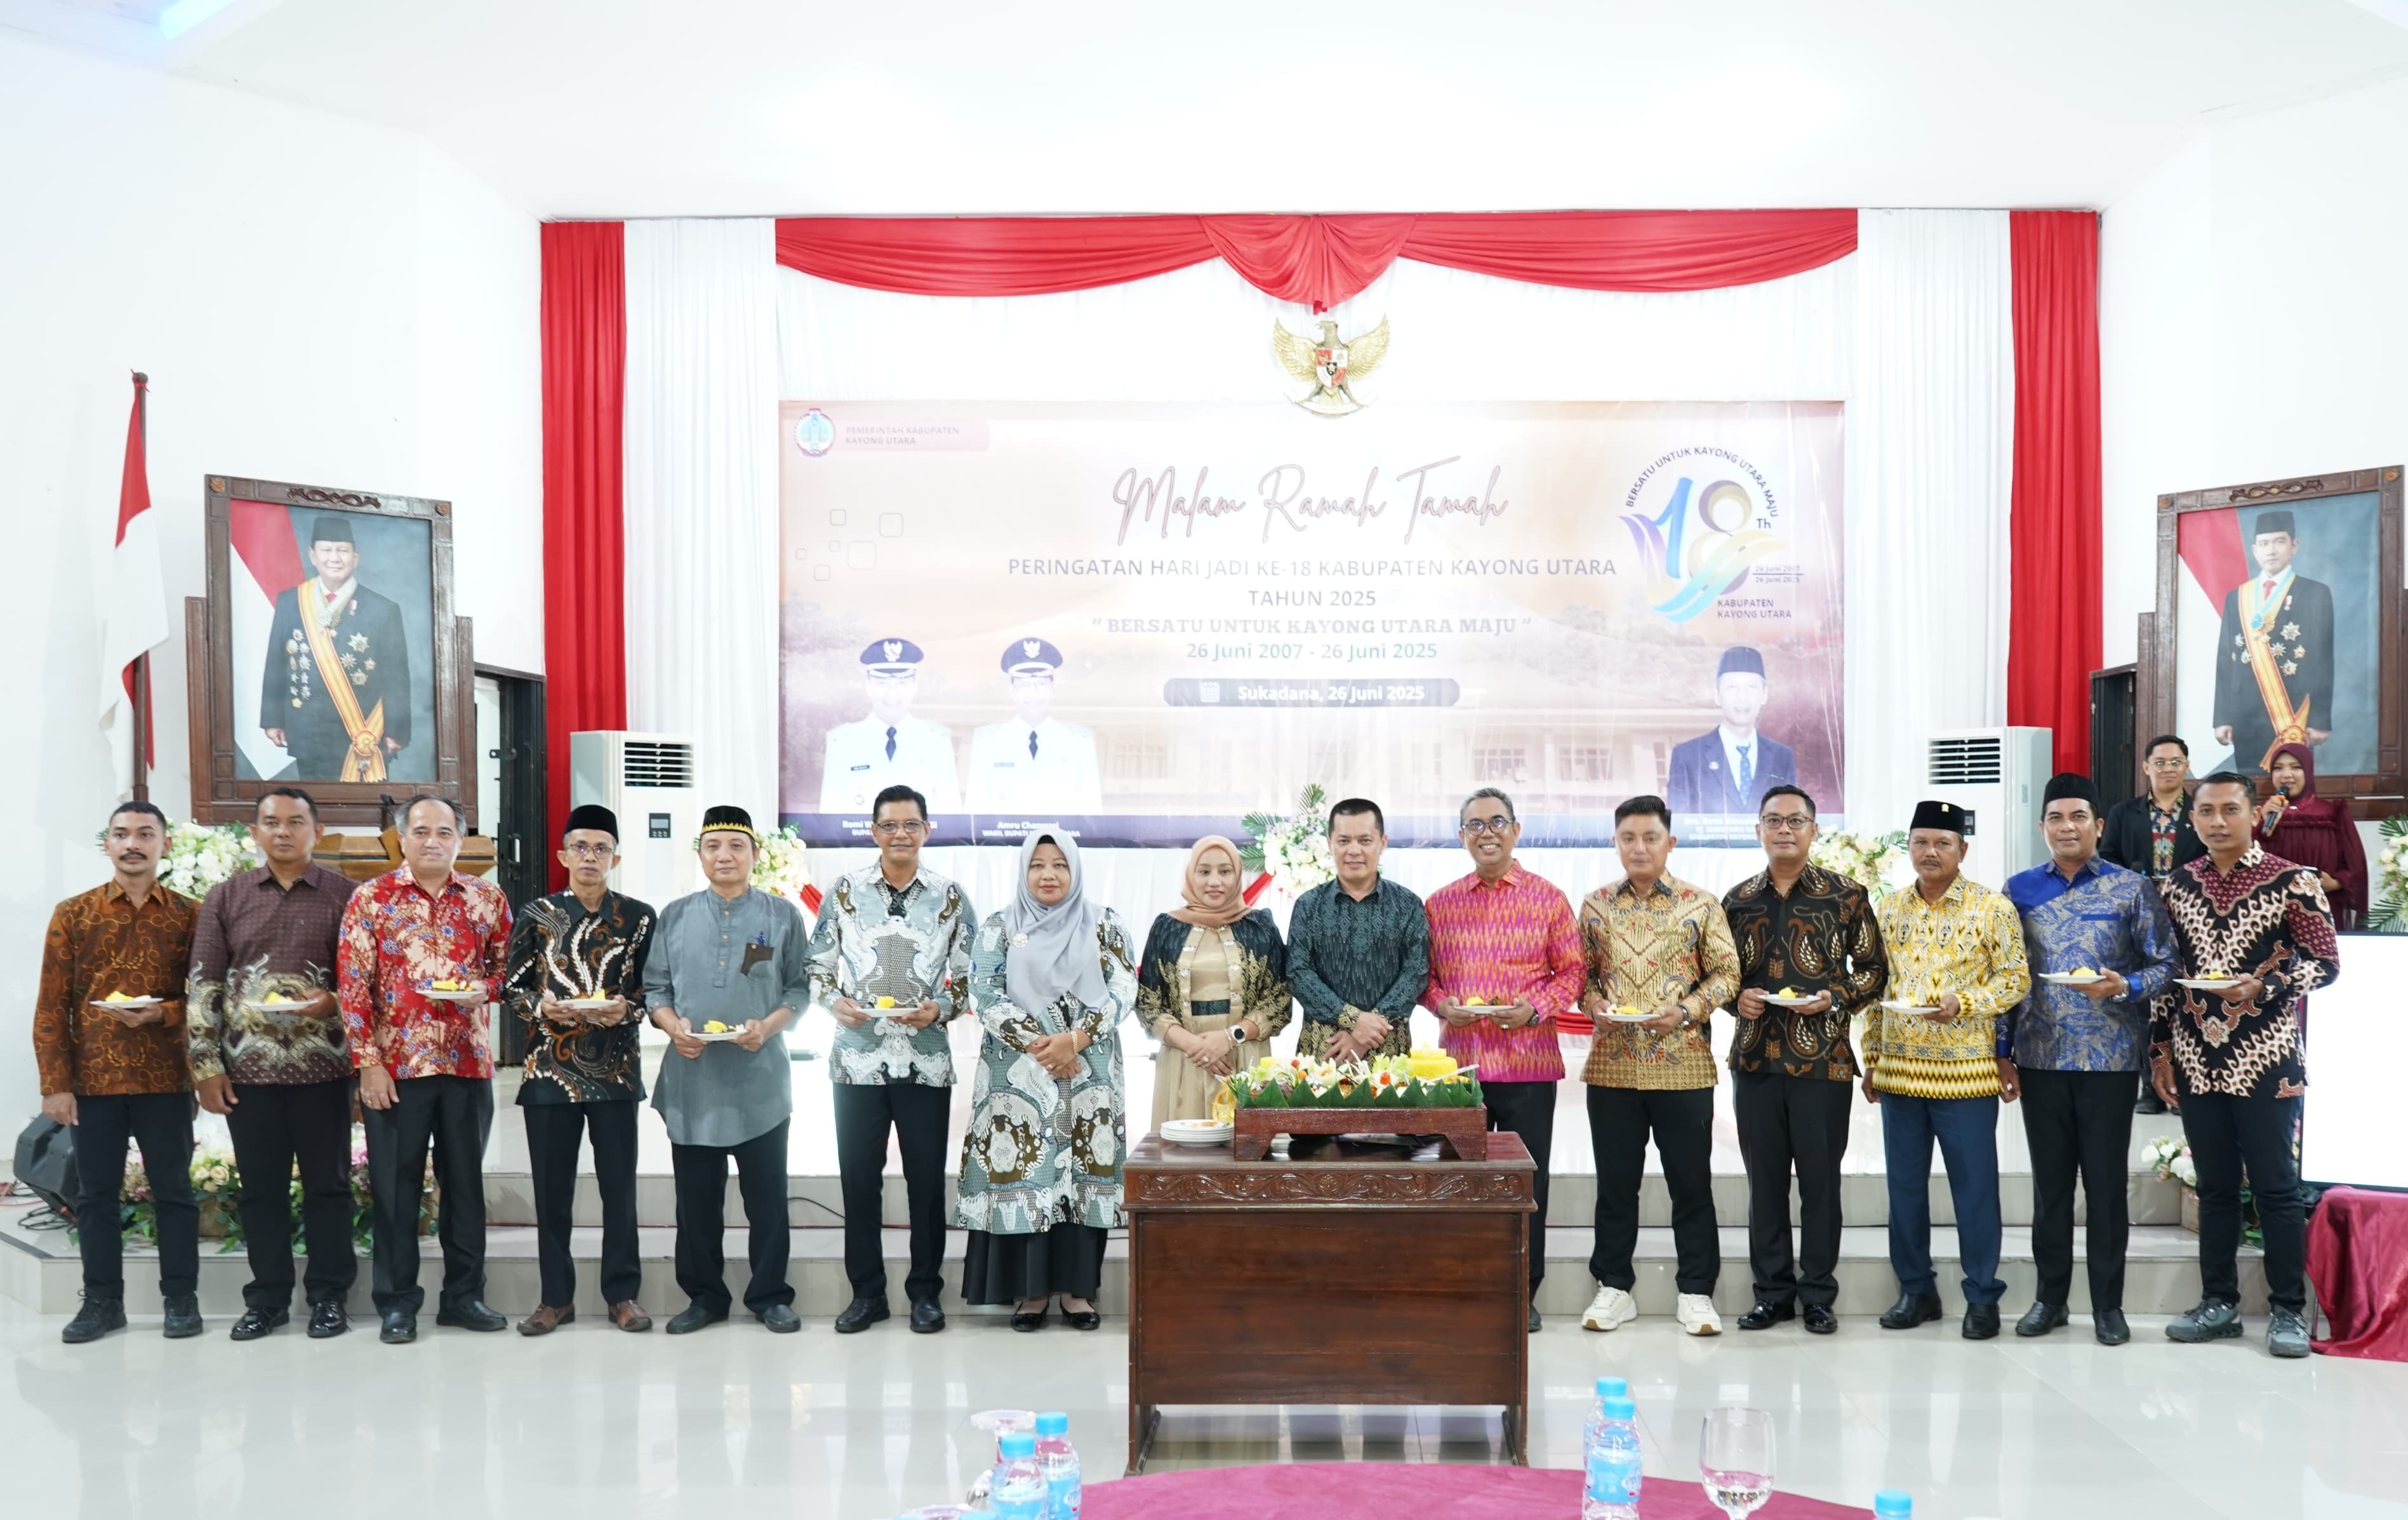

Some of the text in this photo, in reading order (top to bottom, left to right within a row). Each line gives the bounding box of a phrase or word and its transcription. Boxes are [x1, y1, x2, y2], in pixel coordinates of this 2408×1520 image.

[1625, 447, 1778, 517] BERSATU UNTUK KAYONG UTARA MAJU
[1113, 455, 1508, 546] Malam Ramah Tamah
[1757, 519, 1771, 529] Th
[1009, 559, 1616, 579] PERINGATAN HARI JADI KE-18 KABUPATEN KAYONG UTARA
[1248, 591, 1376, 606] TAHUN 2025
[1717, 599, 1774, 607] KABUPATEN
[1717, 610, 1792, 619] KAYONG UTARA
[1108, 619, 1202, 633] BERSATU
[1210, 619, 1281, 633] UNTUK
[1288, 619, 1375, 633] KAYONG
[1381, 619, 1453, 633] UTARA
[1460, 619, 1516, 636] MAJU
[1187, 644, 1207, 658] 26
[1213, 643, 1251, 662] Juni
[1259, 644, 1302, 659] 2007
[1322, 644, 1343, 659] 26
[1347, 643, 1386, 663] Juni
[1393, 644, 1437, 658] 2025
[1238, 685, 1425, 703] Sukadana, 26 Juni 2025
